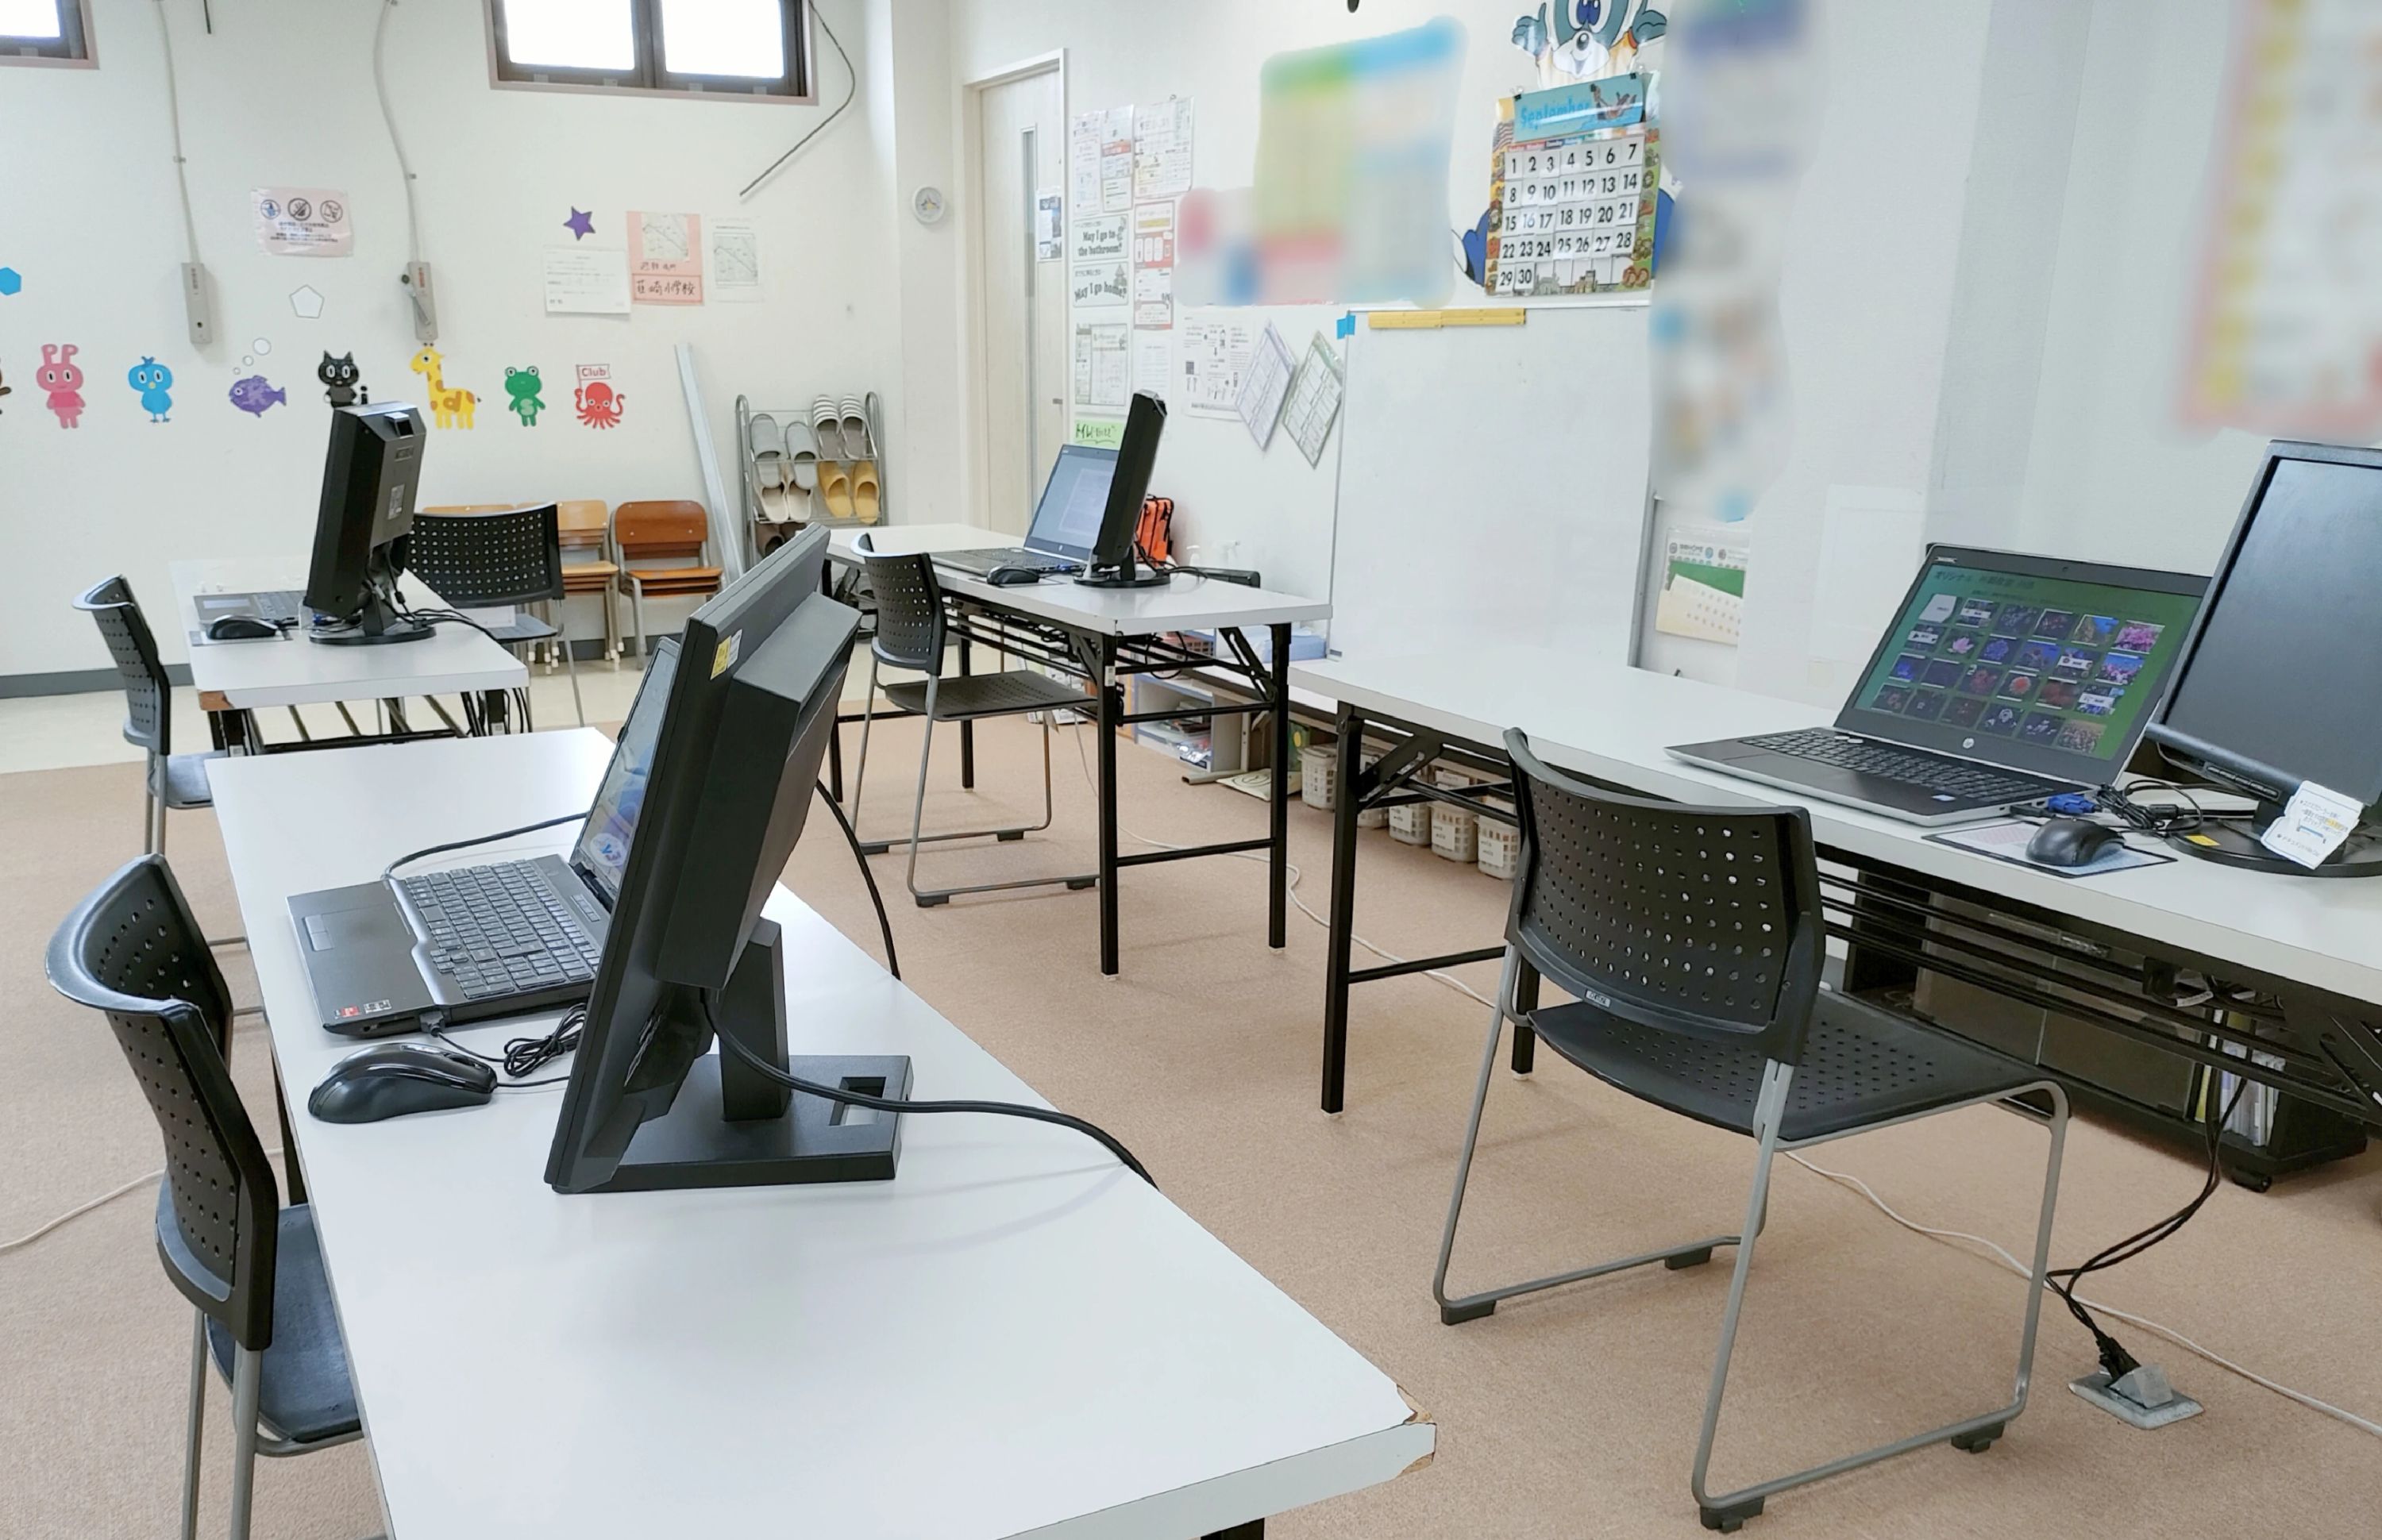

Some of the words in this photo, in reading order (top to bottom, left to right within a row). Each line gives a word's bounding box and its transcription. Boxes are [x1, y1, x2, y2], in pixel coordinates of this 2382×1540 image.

[1512, 158, 1516, 174] 1
[1528, 156, 1536, 172] 2
[1546, 156, 1554, 172] 3
[1567, 152, 1575, 167] 4
[1586, 150, 1593, 166] 5
[1606, 148, 1615, 164] 6
[1628, 144, 1636, 160] 7
[1509, 187, 1517, 202] 8
[1527, 184, 1536, 200] 9
[1543, 185, 1556, 200] 10
[1563, 180, 1575, 197] 11
[1582, 179, 1595, 194] 12
[1602, 176, 1615, 194] 13
[1623, 173, 1637, 190] 14
[1505, 215, 1517, 231] 15
[1523, 213, 1536, 229] 16
[1540, 213, 1554, 229] 17
[1561, 209, 1573, 225] 18
[1579, 207, 1592, 224] 19
[1598, 206, 1613, 222] 20
[1619, 202, 1633, 219] 21
[1082, 231, 1096, 243] May
[1100, 232, 1108, 242] go
[1502, 244, 1515, 259] 22
[1520, 241, 1533, 257] 23
[1536, 241, 1551, 257] 24
[1558, 238, 1571, 252] 25
[1575, 237, 1590, 252] 26
[1594, 236, 1611, 252] 27
[1616, 232, 1632, 248] 28
[1499, 271, 1513, 286] 29
[1518, 268, 1532, 284] 30
[581, 368, 607, 377] Club
